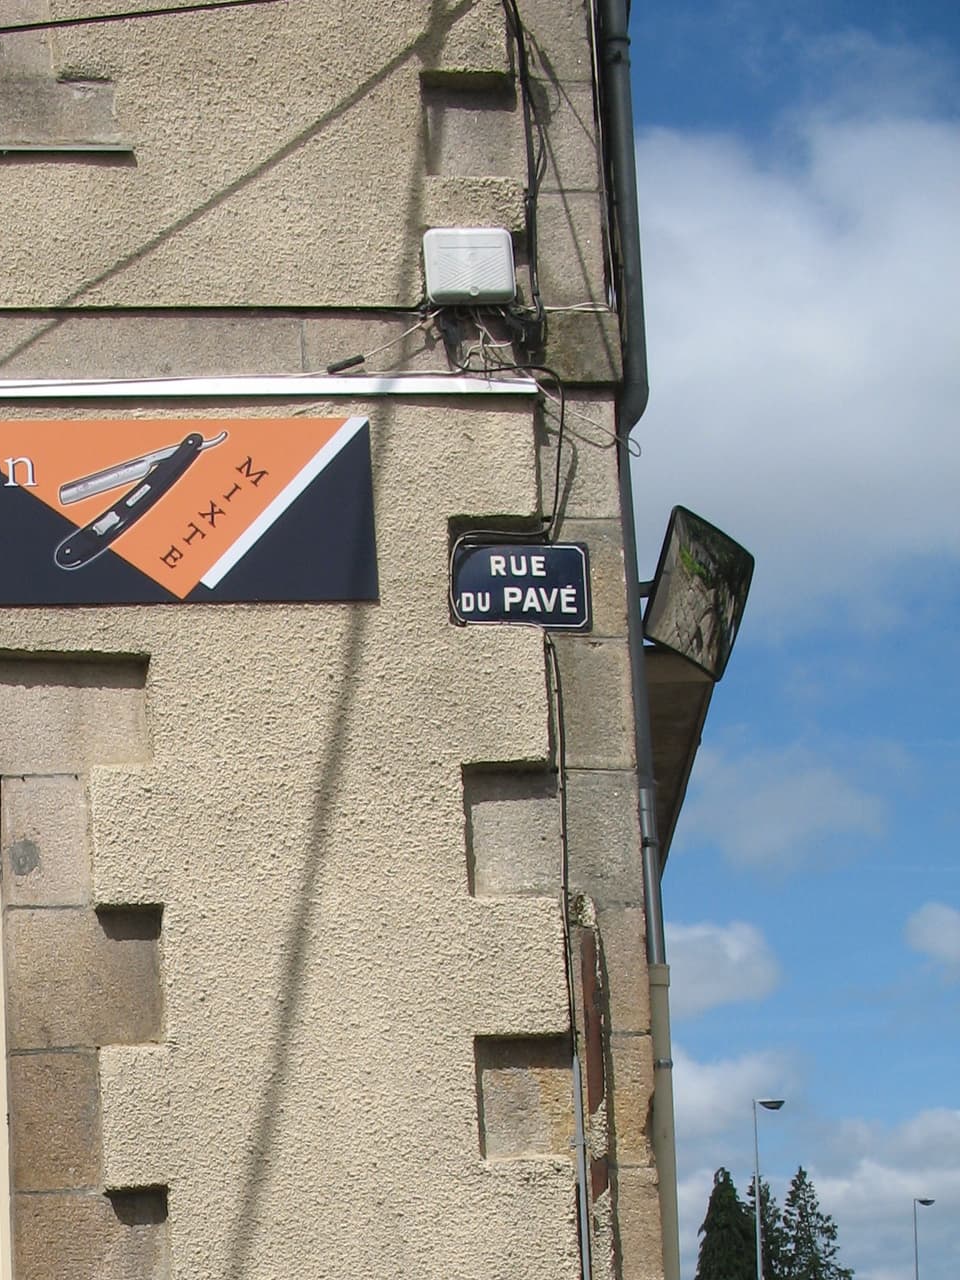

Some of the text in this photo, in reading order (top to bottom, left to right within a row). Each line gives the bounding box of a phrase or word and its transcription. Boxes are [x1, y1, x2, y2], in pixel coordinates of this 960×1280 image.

[160, 456, 269, 568] MIXTE
[490, 555, 547, 577] RUE
[461, 585, 578, 614] DU PAVÉ
